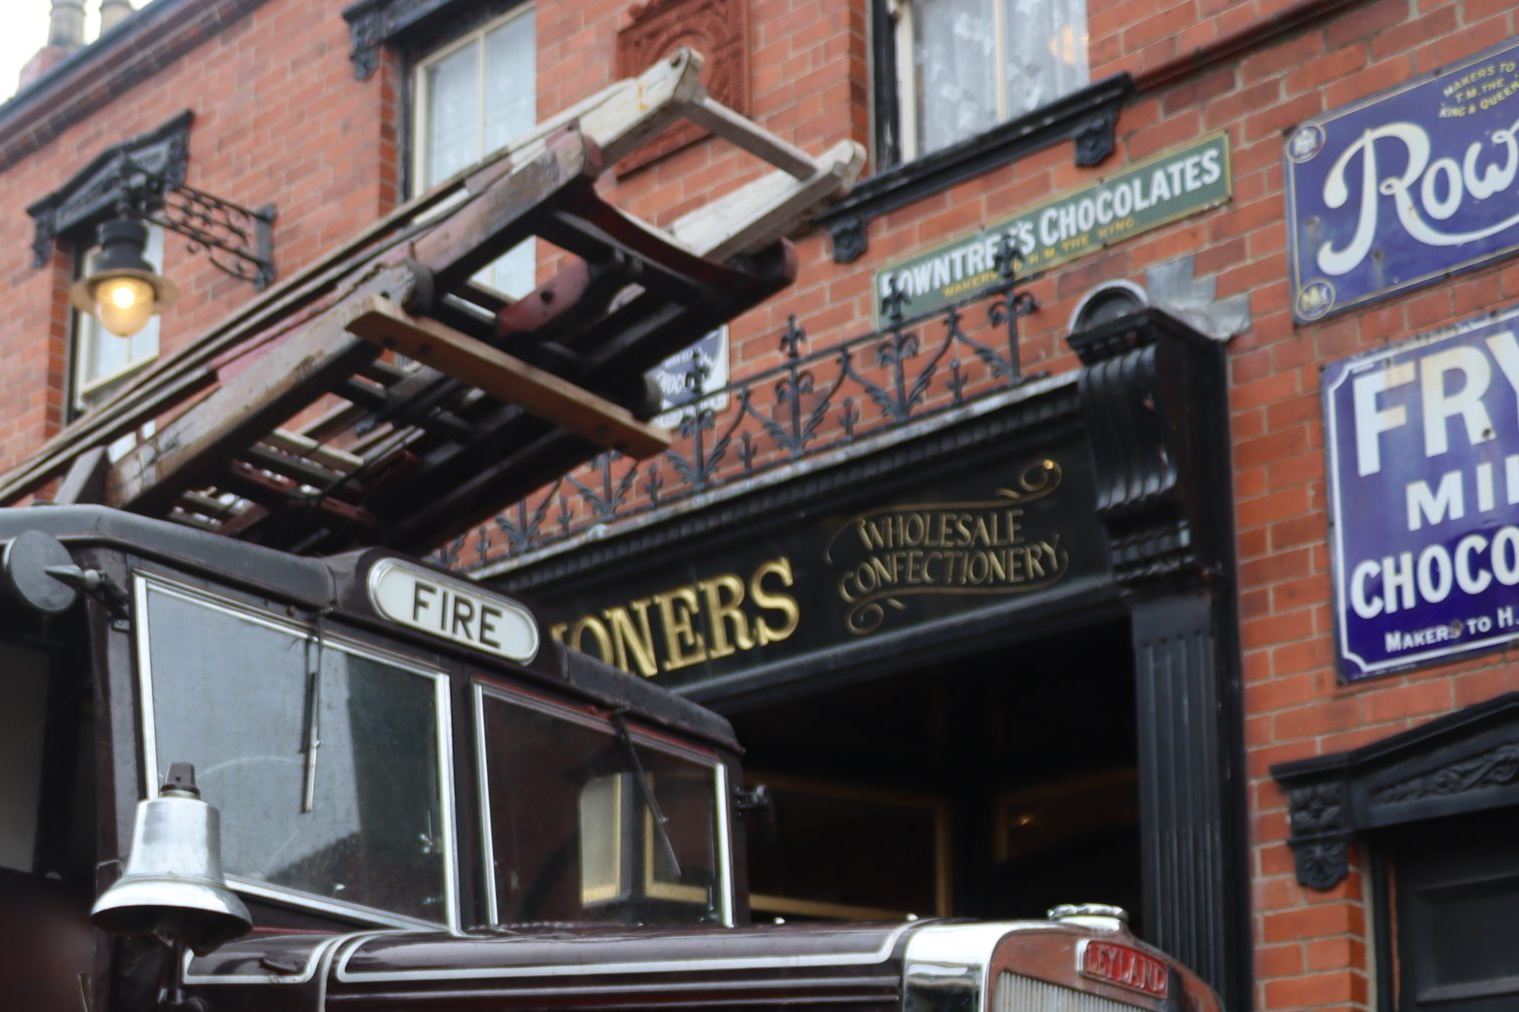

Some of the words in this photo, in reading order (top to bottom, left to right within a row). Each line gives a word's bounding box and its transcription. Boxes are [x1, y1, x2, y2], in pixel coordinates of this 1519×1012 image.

[1499, 61, 1516, 73] TO
[882, 222, 1036, 297] OWNTRE'S
[1040, 149, 1221, 246] CHOCOLATES
[1062, 235, 1090, 252] THE
[856, 509, 1024, 550] WHOLESALE
[839, 533, 1060, 603] CONFECTIONERY
[412, 581, 503, 649] FIRE
[550, 556, 800, 678] ONERS
[1466, 616, 1492, 635] TO
[1086, 942, 1167, 993] LEYLAND
